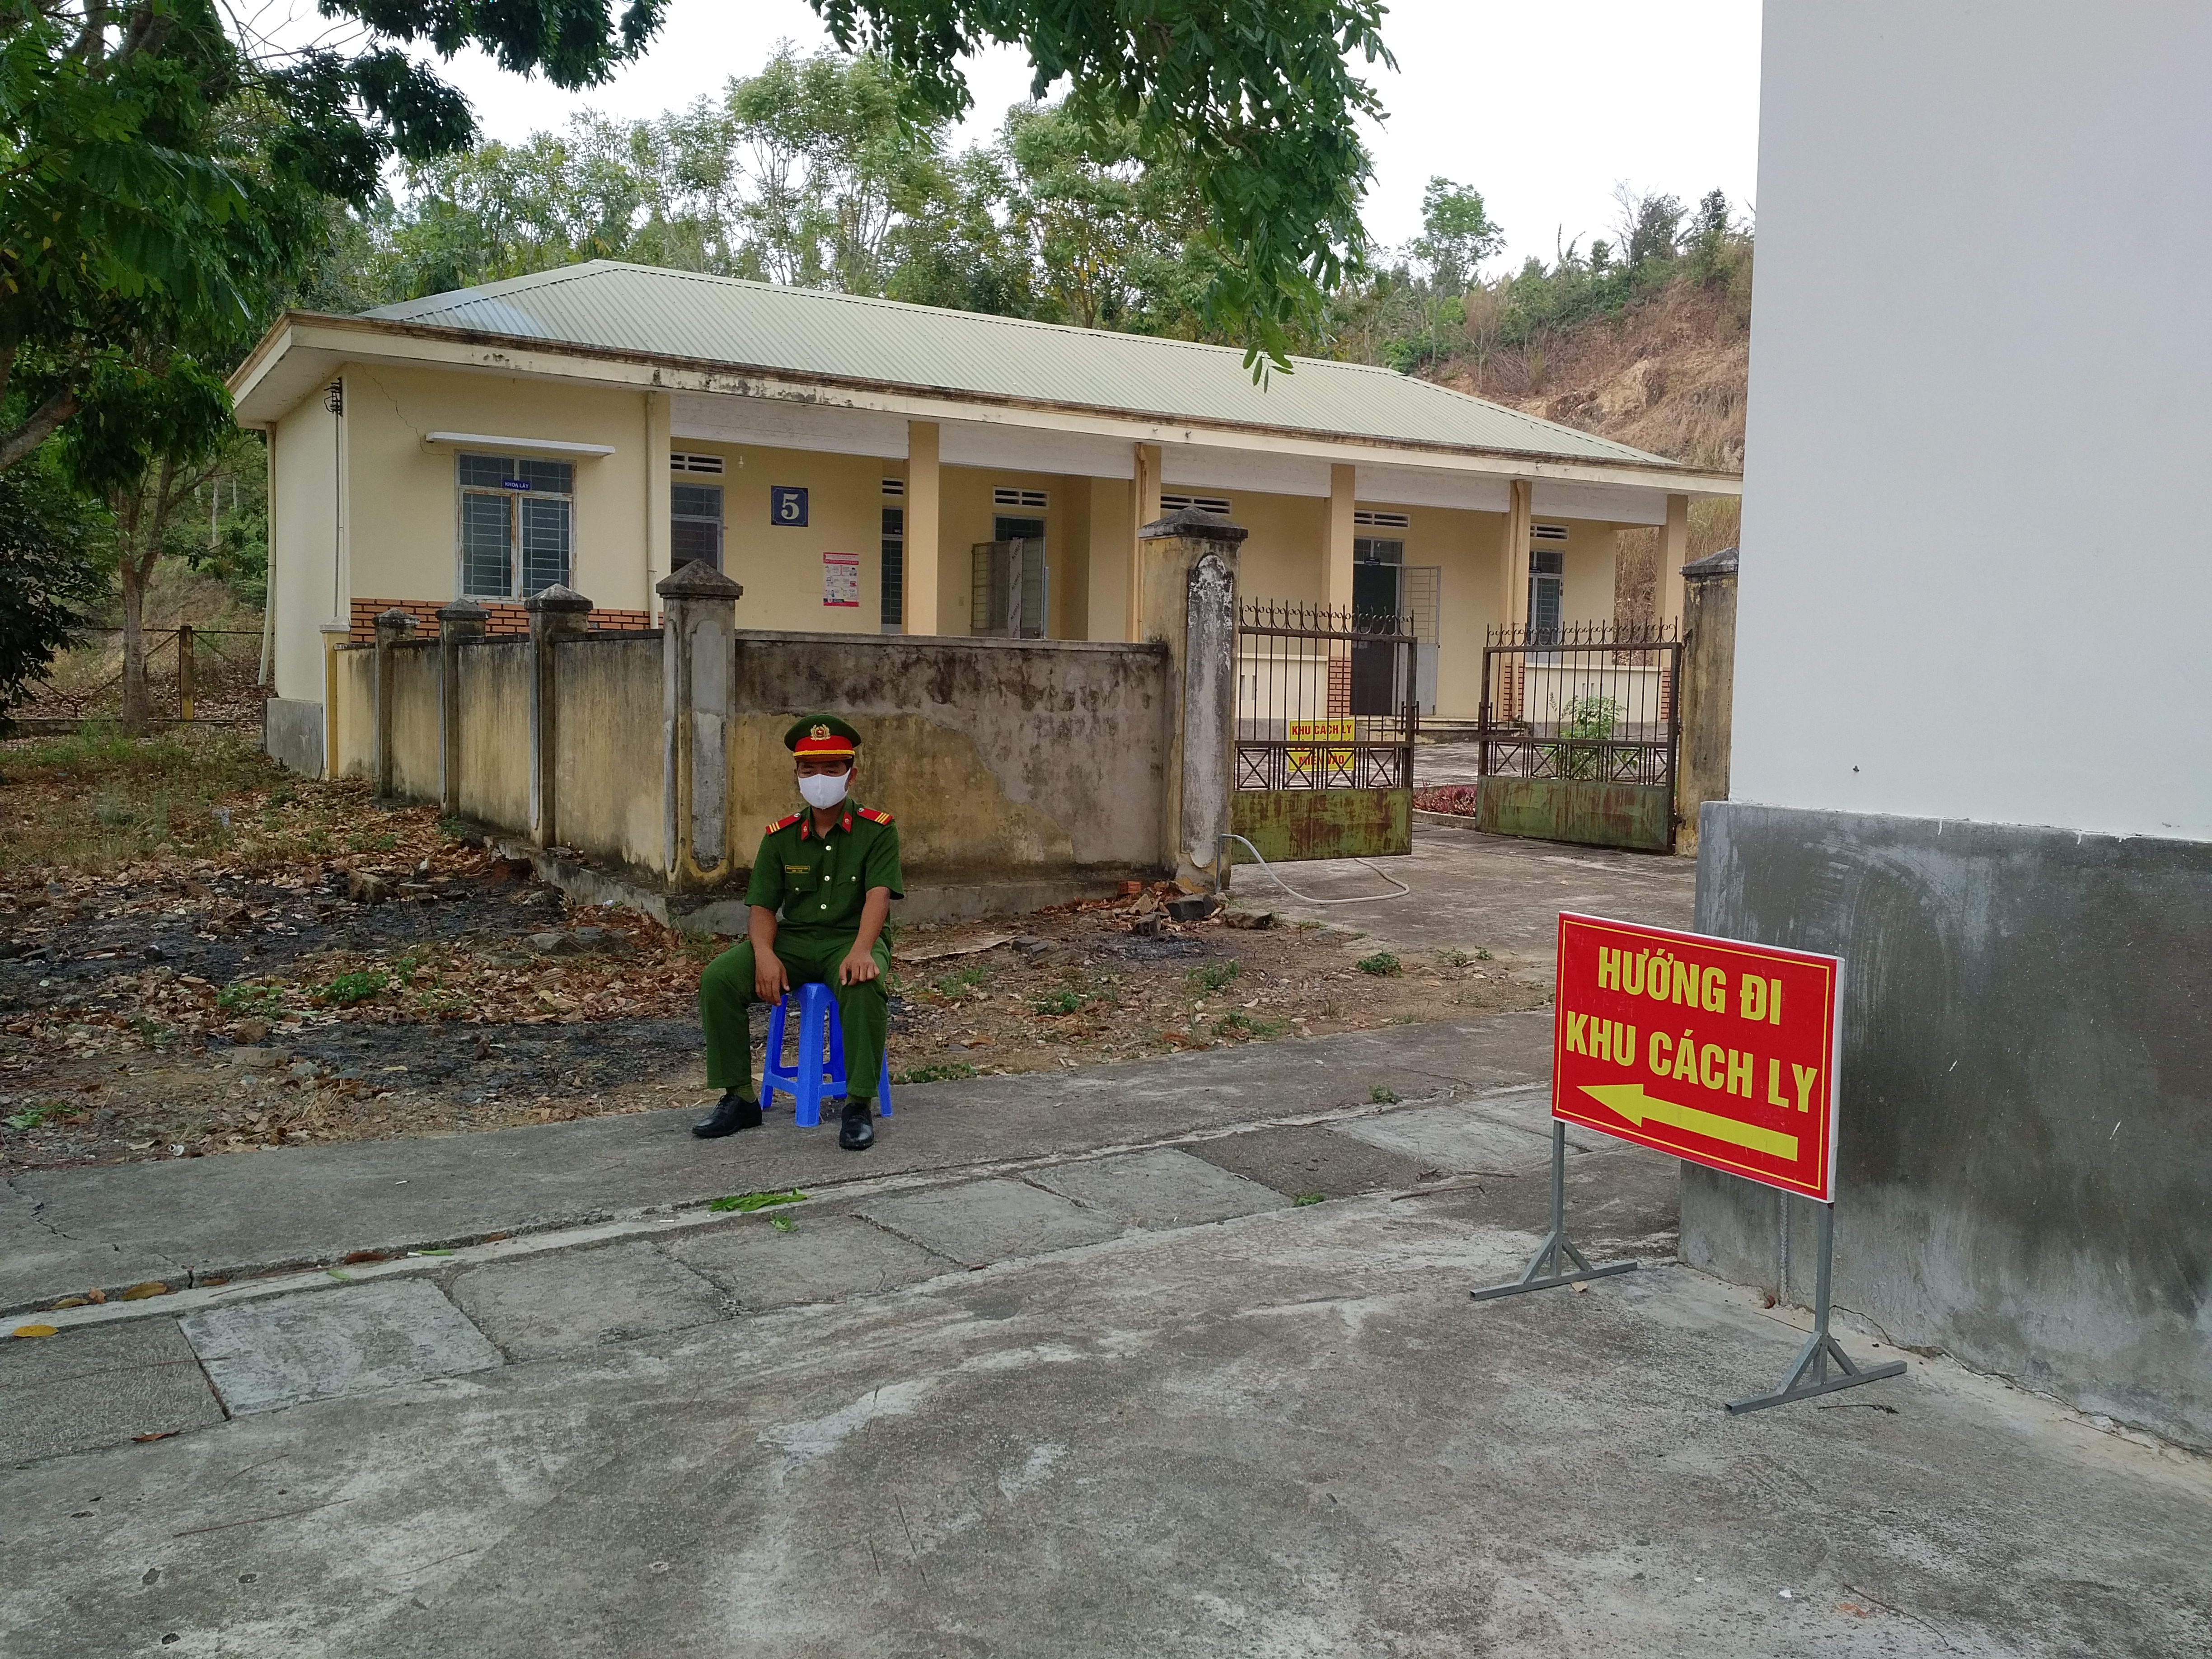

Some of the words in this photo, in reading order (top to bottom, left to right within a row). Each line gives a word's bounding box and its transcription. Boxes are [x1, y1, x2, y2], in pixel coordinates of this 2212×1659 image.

[781, 493, 800, 520] 5
[1292, 725, 1311, 735] KHU
[1314, 723, 1339, 735] CÁCH
[1342, 724, 1352, 734] LY
[1598, 946, 1726, 1014] HƯỚNG
[1739, 973, 1781, 1025] ĐI
[1566, 1010, 1636, 1067] KHU
[1649, 1029, 1753, 1098] CÁCH
[1768, 1058, 1818, 1113] LY
